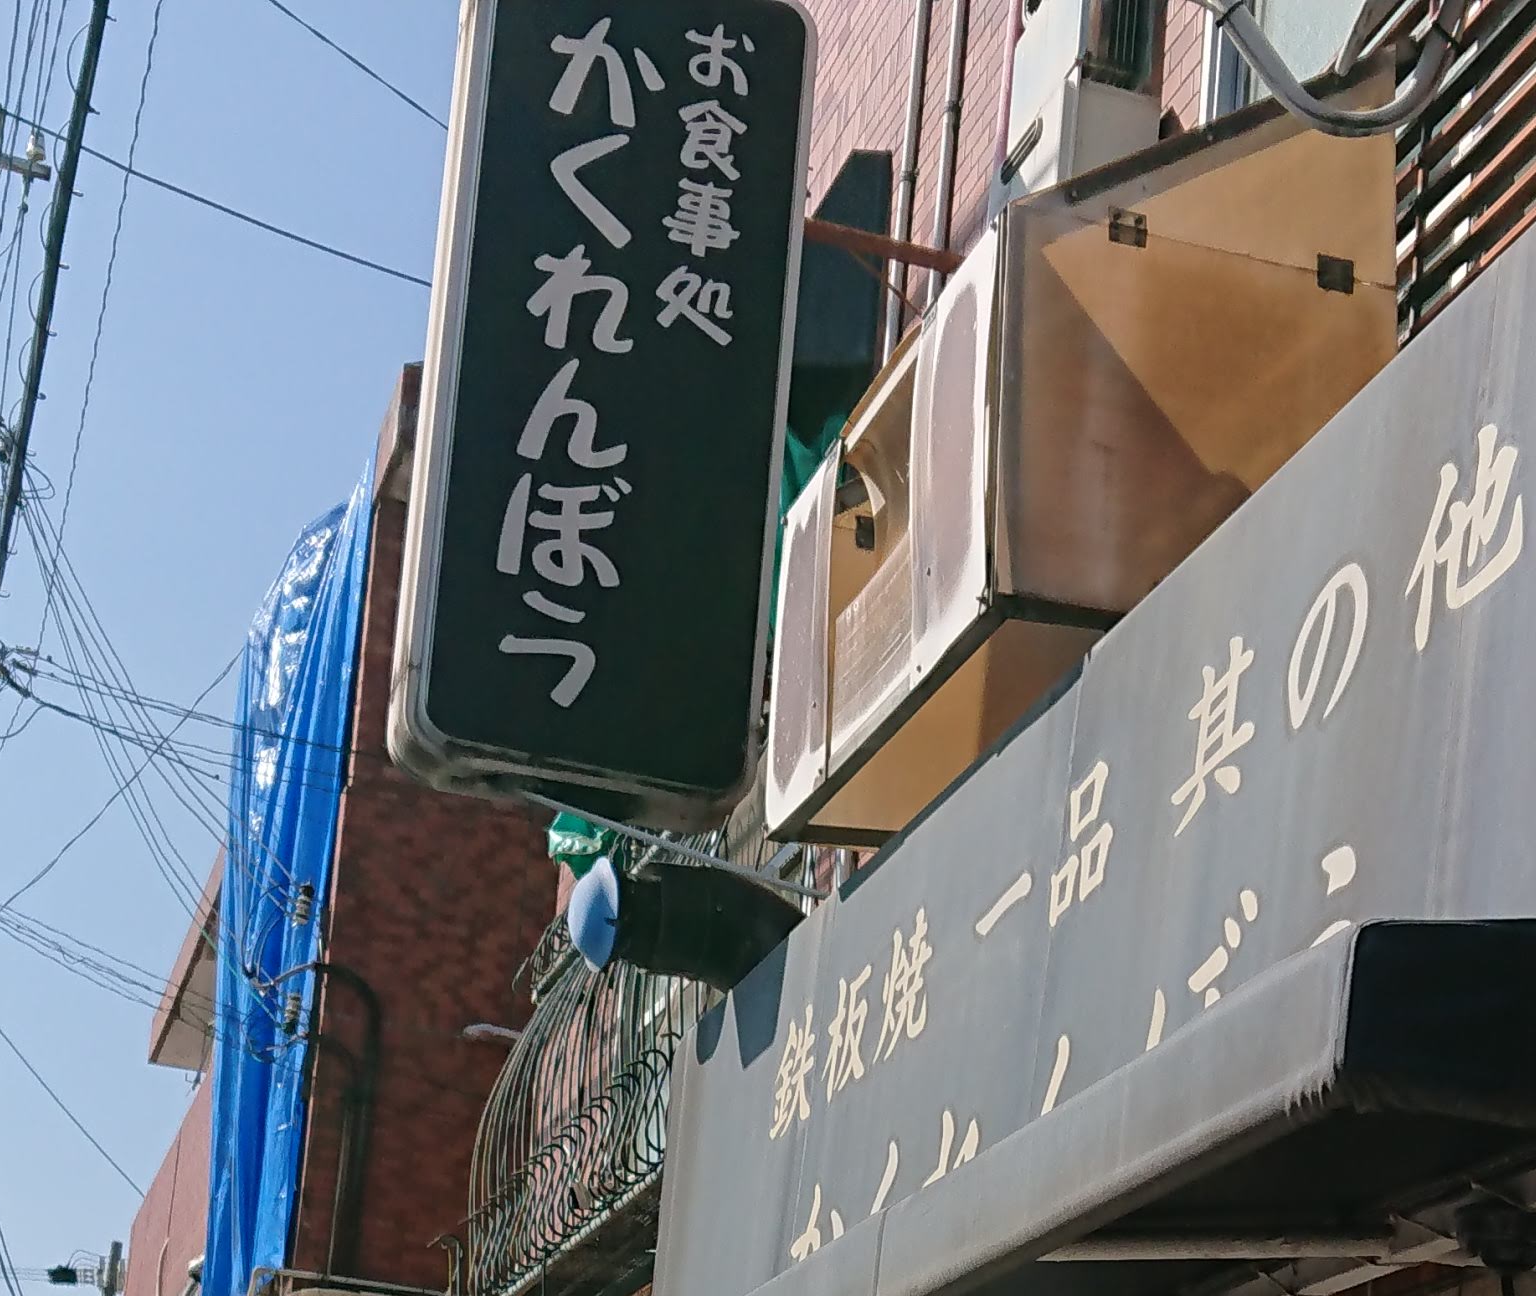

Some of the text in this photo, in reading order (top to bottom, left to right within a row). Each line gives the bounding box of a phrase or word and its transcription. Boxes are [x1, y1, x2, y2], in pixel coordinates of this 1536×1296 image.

[495, 16, 666, 710] かくれんぼう
[656, 23, 755, 348] お食事処
